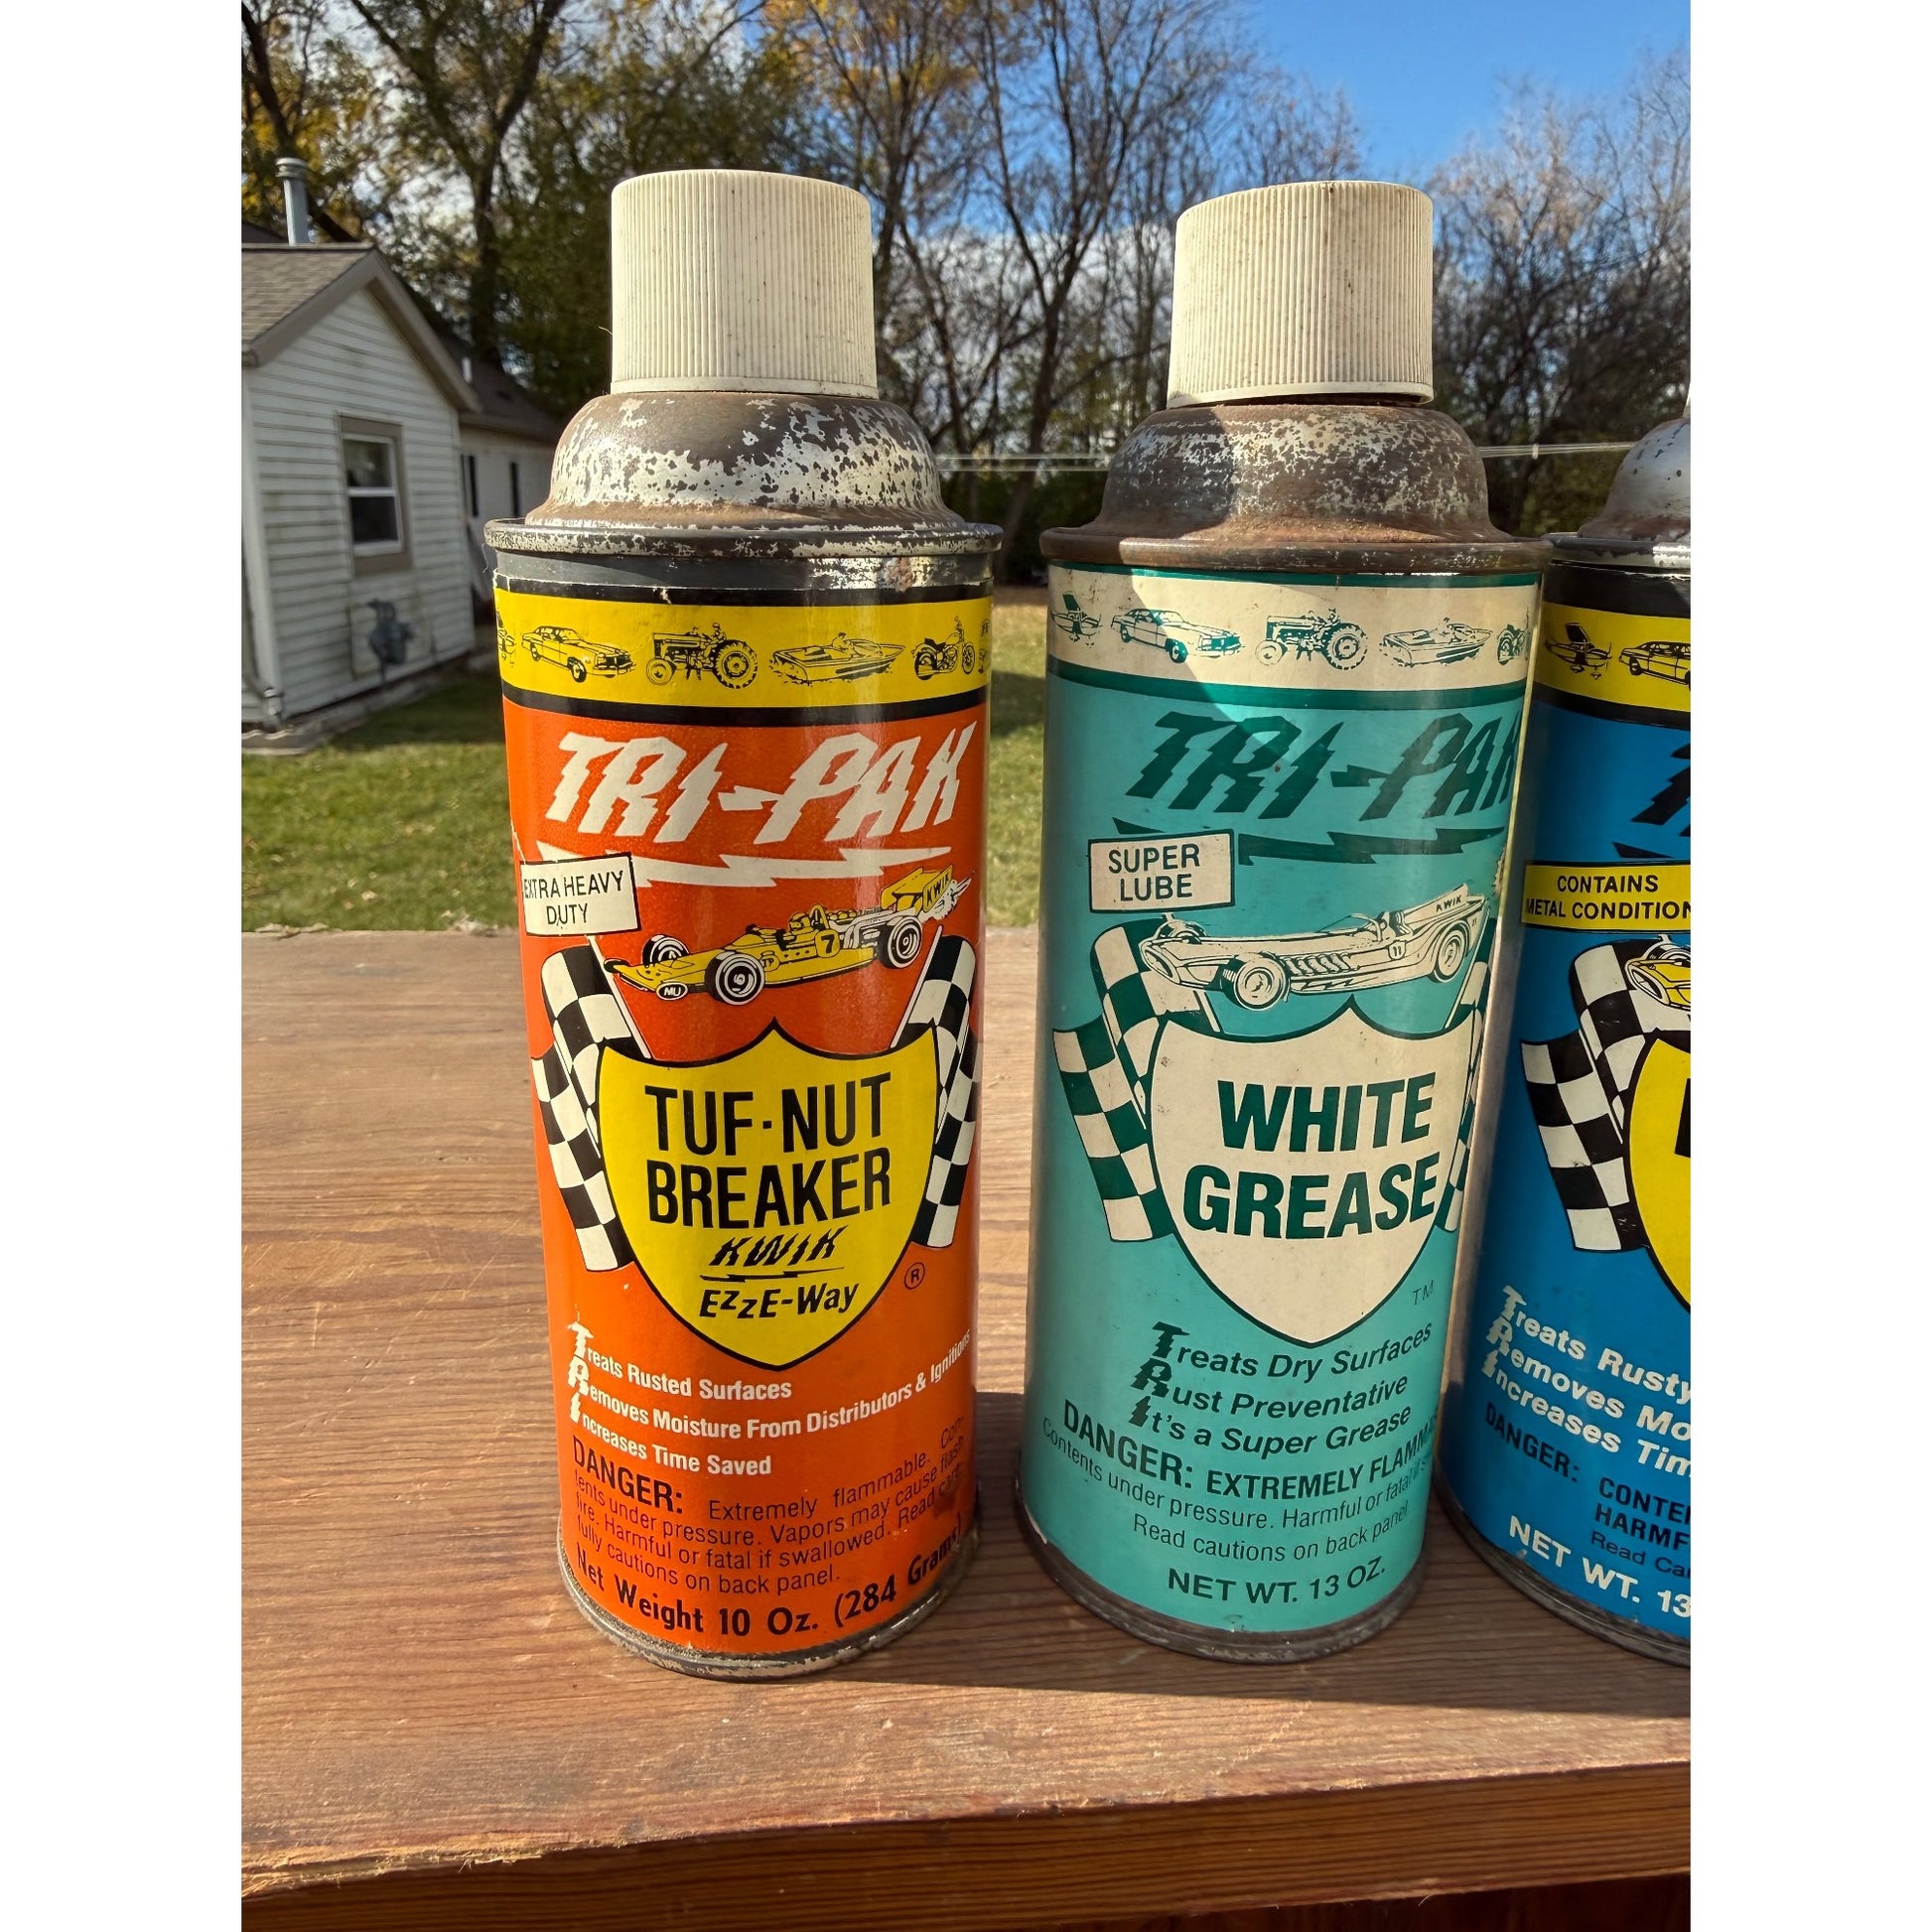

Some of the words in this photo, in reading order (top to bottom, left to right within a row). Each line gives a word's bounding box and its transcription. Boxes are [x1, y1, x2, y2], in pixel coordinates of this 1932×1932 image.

[545, 721, 978, 845] TRI-PAK
[1125, 710, 1522, 821] TRI-PAK
[524, 878, 561, 898] EXTRA
[563, 870, 623, 897] HEAVY
[1109, 843, 1200, 874] SUPER
[1119, 874, 1192, 902] LUBE
[1557, 875, 1659, 894] CONTAINS
[546, 902, 588, 925] DUTY
[820, 934, 836, 953] 7
[1525, 897, 1567, 917] METAL
[1217, 1071, 1436, 1152] WHITE
[645, 1147, 892, 1230] BREAKER
[1182, 1152, 1440, 1239] GREASE
[709, 1225, 849, 1267] KWIK
[567, 1356, 649, 1426] Removes
[653, 1408, 742, 1440] Moisture
[747, 1419, 801, 1440] From
[806, 1382, 912, 1434] Distributors
[915, 1372, 926, 1392] &
[930, 1329, 971, 1383] Ignitions
[569, 1321, 623, 1379] Treats
[626, 1363, 692, 1397] Rusted
[699, 1378, 792, 1401] Surfaces
[1152, 1321, 1259, 1377] Treats
[1268, 1354, 1323, 1383] Dry
[1330, 1322, 1433, 1375] Surfaces
[1486, 1314, 1625, 1419] Removes
[1502, 1285, 1587, 1360] Treats
[1597, 1348, 1691, 1405] Rusty
[1131, 1358, 1222, 1414] Rust
[1230, 1375, 1408, 1421] Preventative
[1481, 1349, 1621, 1453] Increases
[570, 1392, 647, 1460] Increases
[652, 1444, 701, 1472] Time
[707, 1455, 771, 1476] Saved
[1042, 1416, 1102, 1481] Contents
[1108, 1471, 1166, 1510] under
[1170, 1498, 1275, 1529] pressure.
[1282, 1496, 1362, 1529] Harmful
[1365, 1490, 1383, 1512] or
[1385, 1467, 1412, 1502] fatal
[1063, 1398, 1192, 1488] DANGER:
[1207, 1464, 1365, 1500] EXTREMELY
[1193, 1428, 1212, 1448] a
[1220, 1427, 1317, 1460] Super
[1325, 1406, 1412, 1451] Grease
[1484, 1401, 1582, 1483] DANGER:
[573, 1435, 683, 1514] DANGER:
[709, 1496, 818, 1521] Extremely
[834, 1452, 930, 1508] flammable.
[609, 1496, 657, 1530] under
[662, 1520, 761, 1546] pressure.
[769, 1517, 845, 1546] Vapors
[851, 1497, 891, 1527] may
[896, 1466, 937, 1507] cause
[576, 1490, 600, 1525] fire.
[604, 1513, 672, 1560] Harmful
[678, 1548, 700, 1565] or
[706, 1548, 751, 1570] fatal
[759, 1549, 771, 1569] if
[778, 1520, 892, 1566] swallowed.
[897, 1489, 935, 1529] Read
[608, 1542, 679, 1586] cautions
[685, 1574, 710, 1591] on
[719, 1575, 770, 1594] back
[777, 1564, 840, 1595] panel.
[1134, 1513, 1185, 1549] Read
[1193, 1537, 1286, 1563] cautions
[1293, 1542, 1318, 1561] on
[1325, 1526, 1368, 1556] back
[1509, 1515, 1571, 1569] NET
[1582, 1556, 1640, 1603] WT.
[1590, 1530, 1646, 1566] Read
[576, 1541, 605, 1591] Net
[614, 1573, 705, 1633] Weight
[719, 1607, 751, 1637] 10
[766, 1606, 818, 1636] Oz.
[833, 1575, 897, 1629] (284
[906, 1512, 962, 1586] Grams)
[1168, 1568, 1237, 1601] NET
[1245, 1581, 1299, 1604] WT.
[1311, 1575, 1339, 1599] 13
[1346, 1556, 1386, 1588] OZ.
